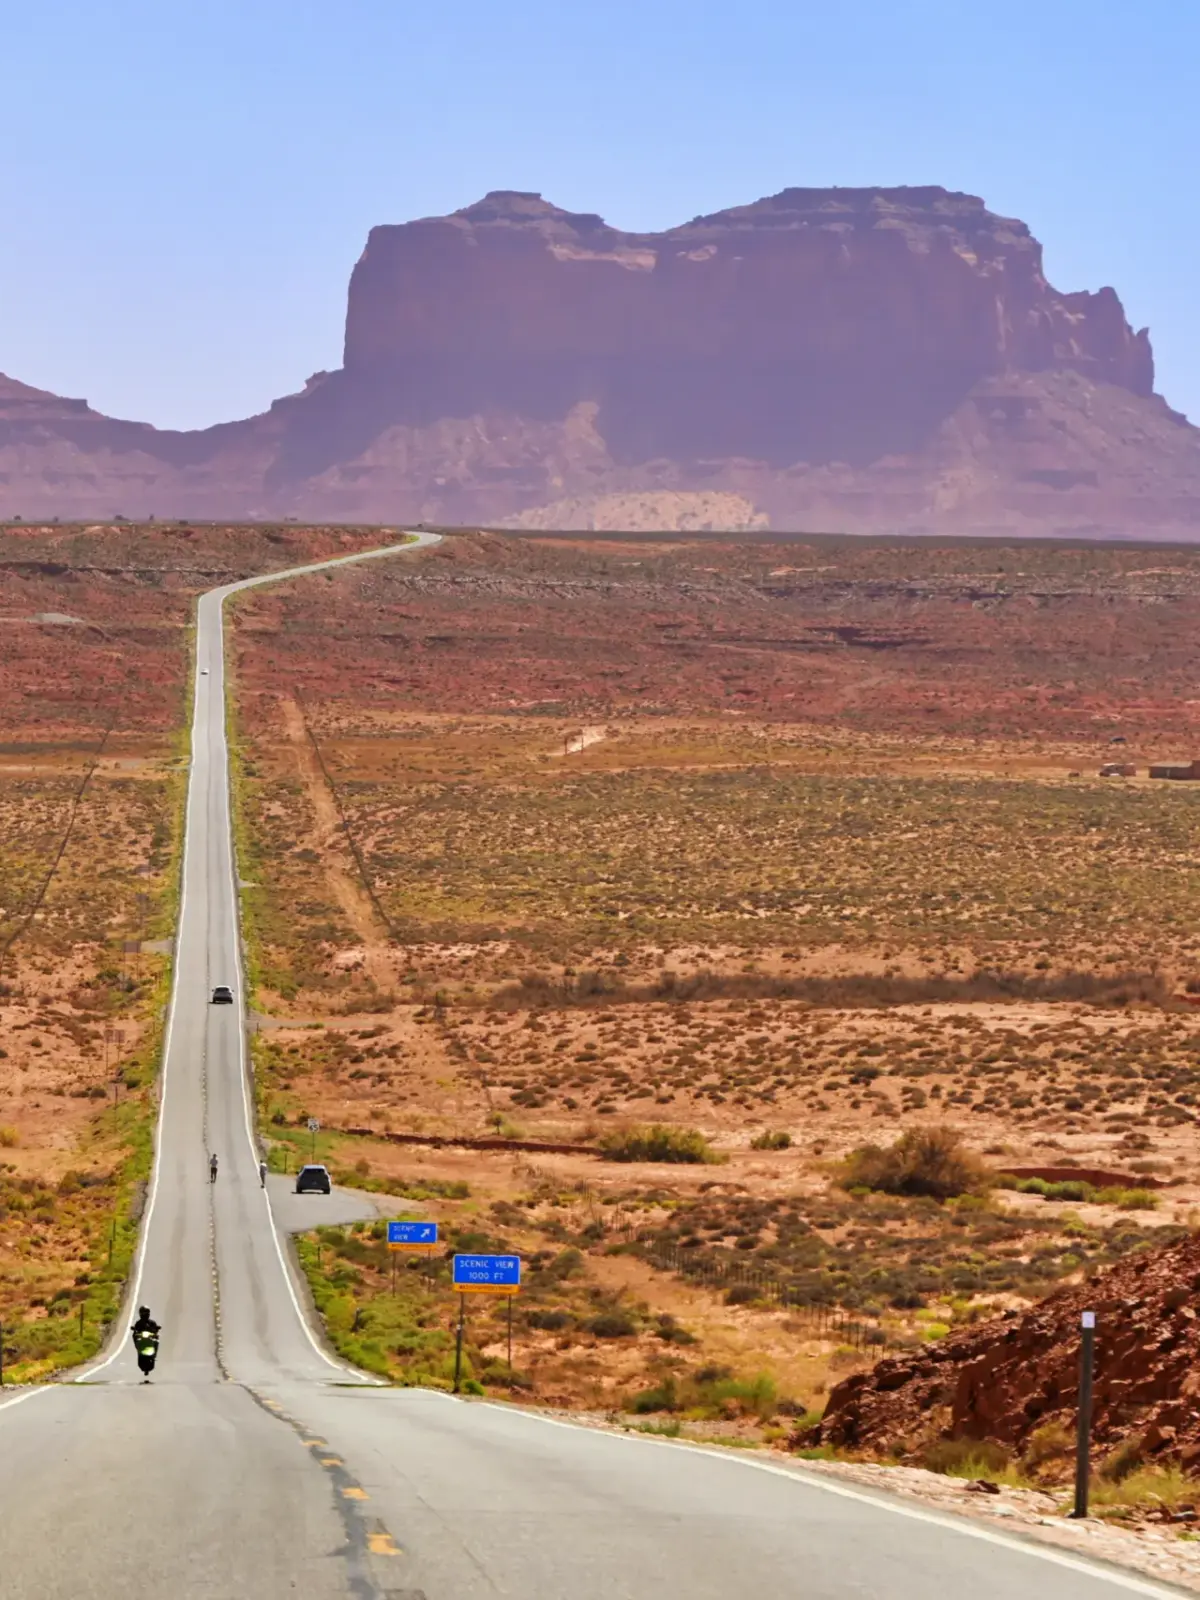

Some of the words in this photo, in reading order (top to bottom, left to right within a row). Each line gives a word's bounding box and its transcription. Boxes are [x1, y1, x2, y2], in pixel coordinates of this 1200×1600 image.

[460, 1260, 489, 1268] SCENIC
[495, 1260, 514, 1269] VIEW
[470, 1272, 489, 1280] 1000
[494, 1272, 504, 1280] FT
